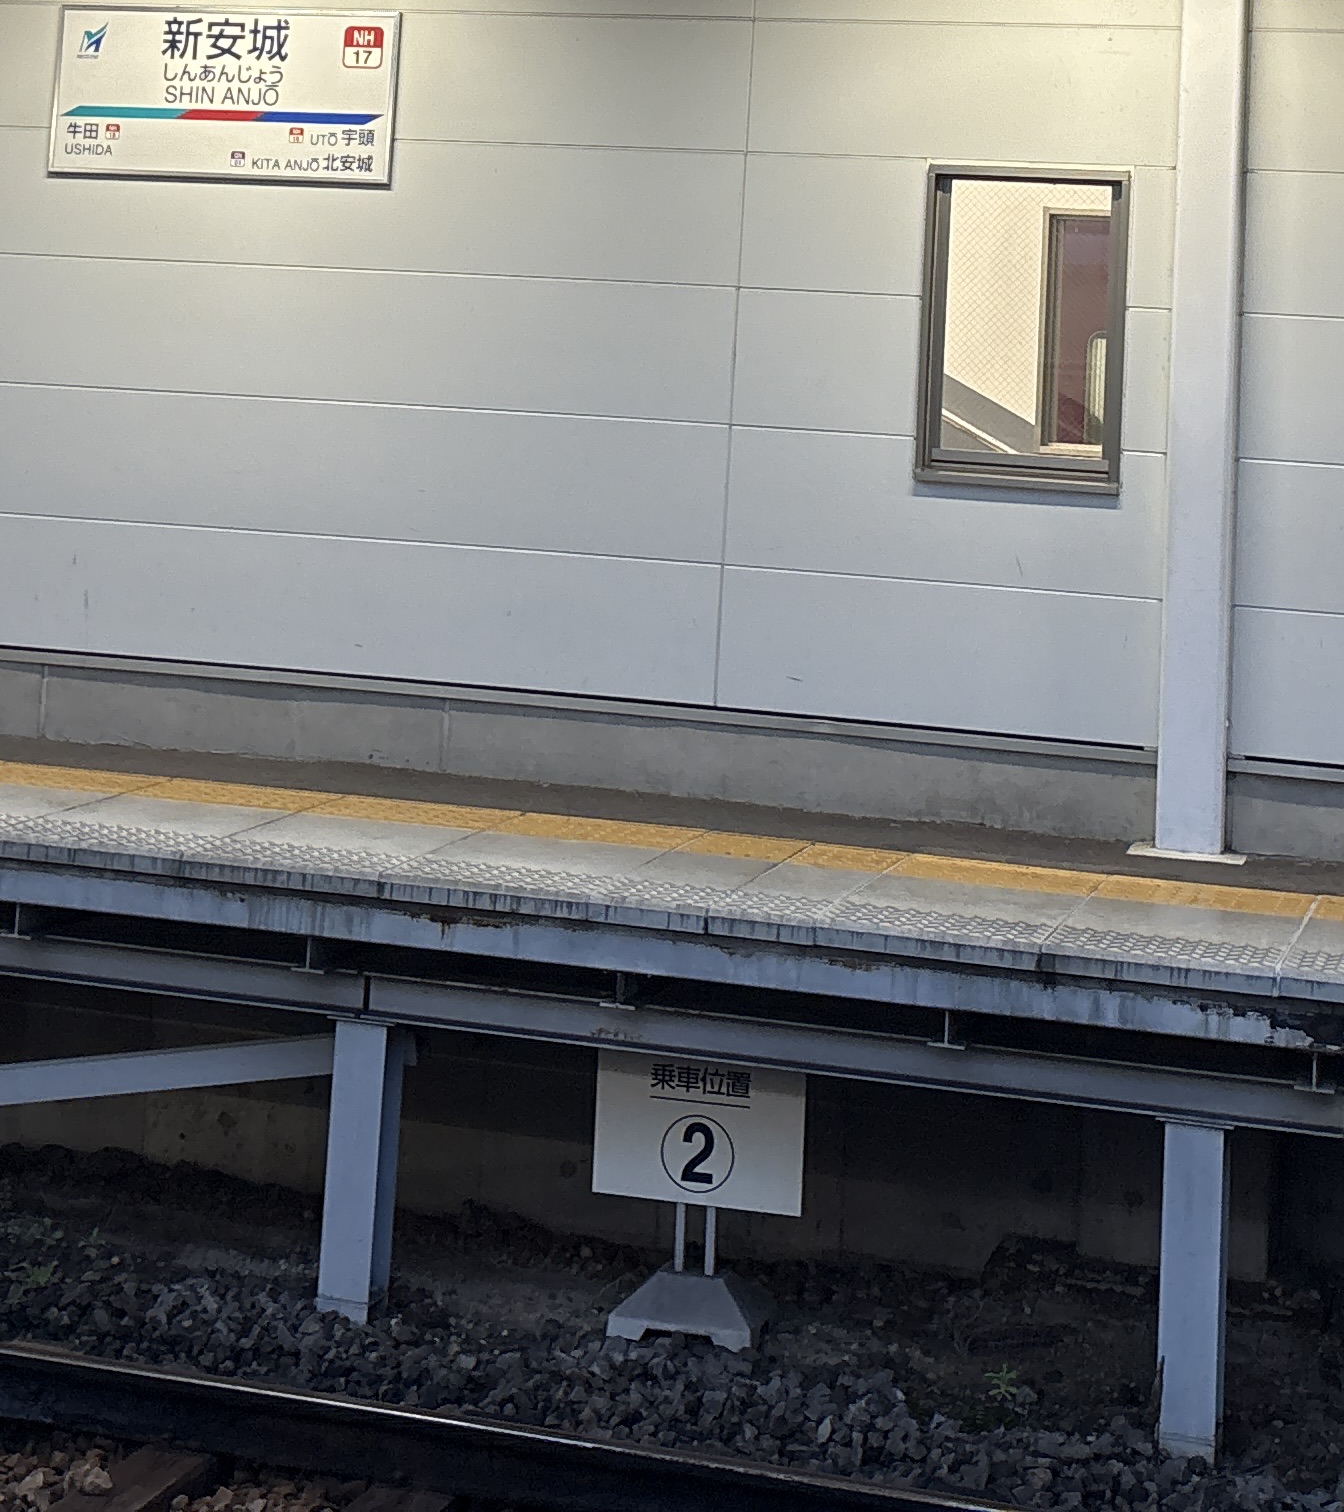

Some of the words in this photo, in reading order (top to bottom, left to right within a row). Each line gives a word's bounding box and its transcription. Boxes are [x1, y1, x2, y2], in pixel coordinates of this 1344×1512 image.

[161, 16, 291, 63] 新安城
[353, 29, 375, 46] NH
[353, 49, 373, 65] 17
[163, 62, 284, 85] しんあんじょう
[164, 84, 215, 104] SHIN
[221, 83, 280, 107] ANJŌ
[66, 121, 100, 140] 牛田
[310, 131, 338, 147] UTŌ
[341, 128, 376, 147] 宇頭
[64, 143, 113, 157] USHIDA
[251, 157, 281, 171] KITA
[284, 157, 321, 173] ANJŌ
[322, 153, 374, 173] 北安城
[650, 1063, 752, 1099] 乗車位置
[681, 1121, 715, 1184] 2
